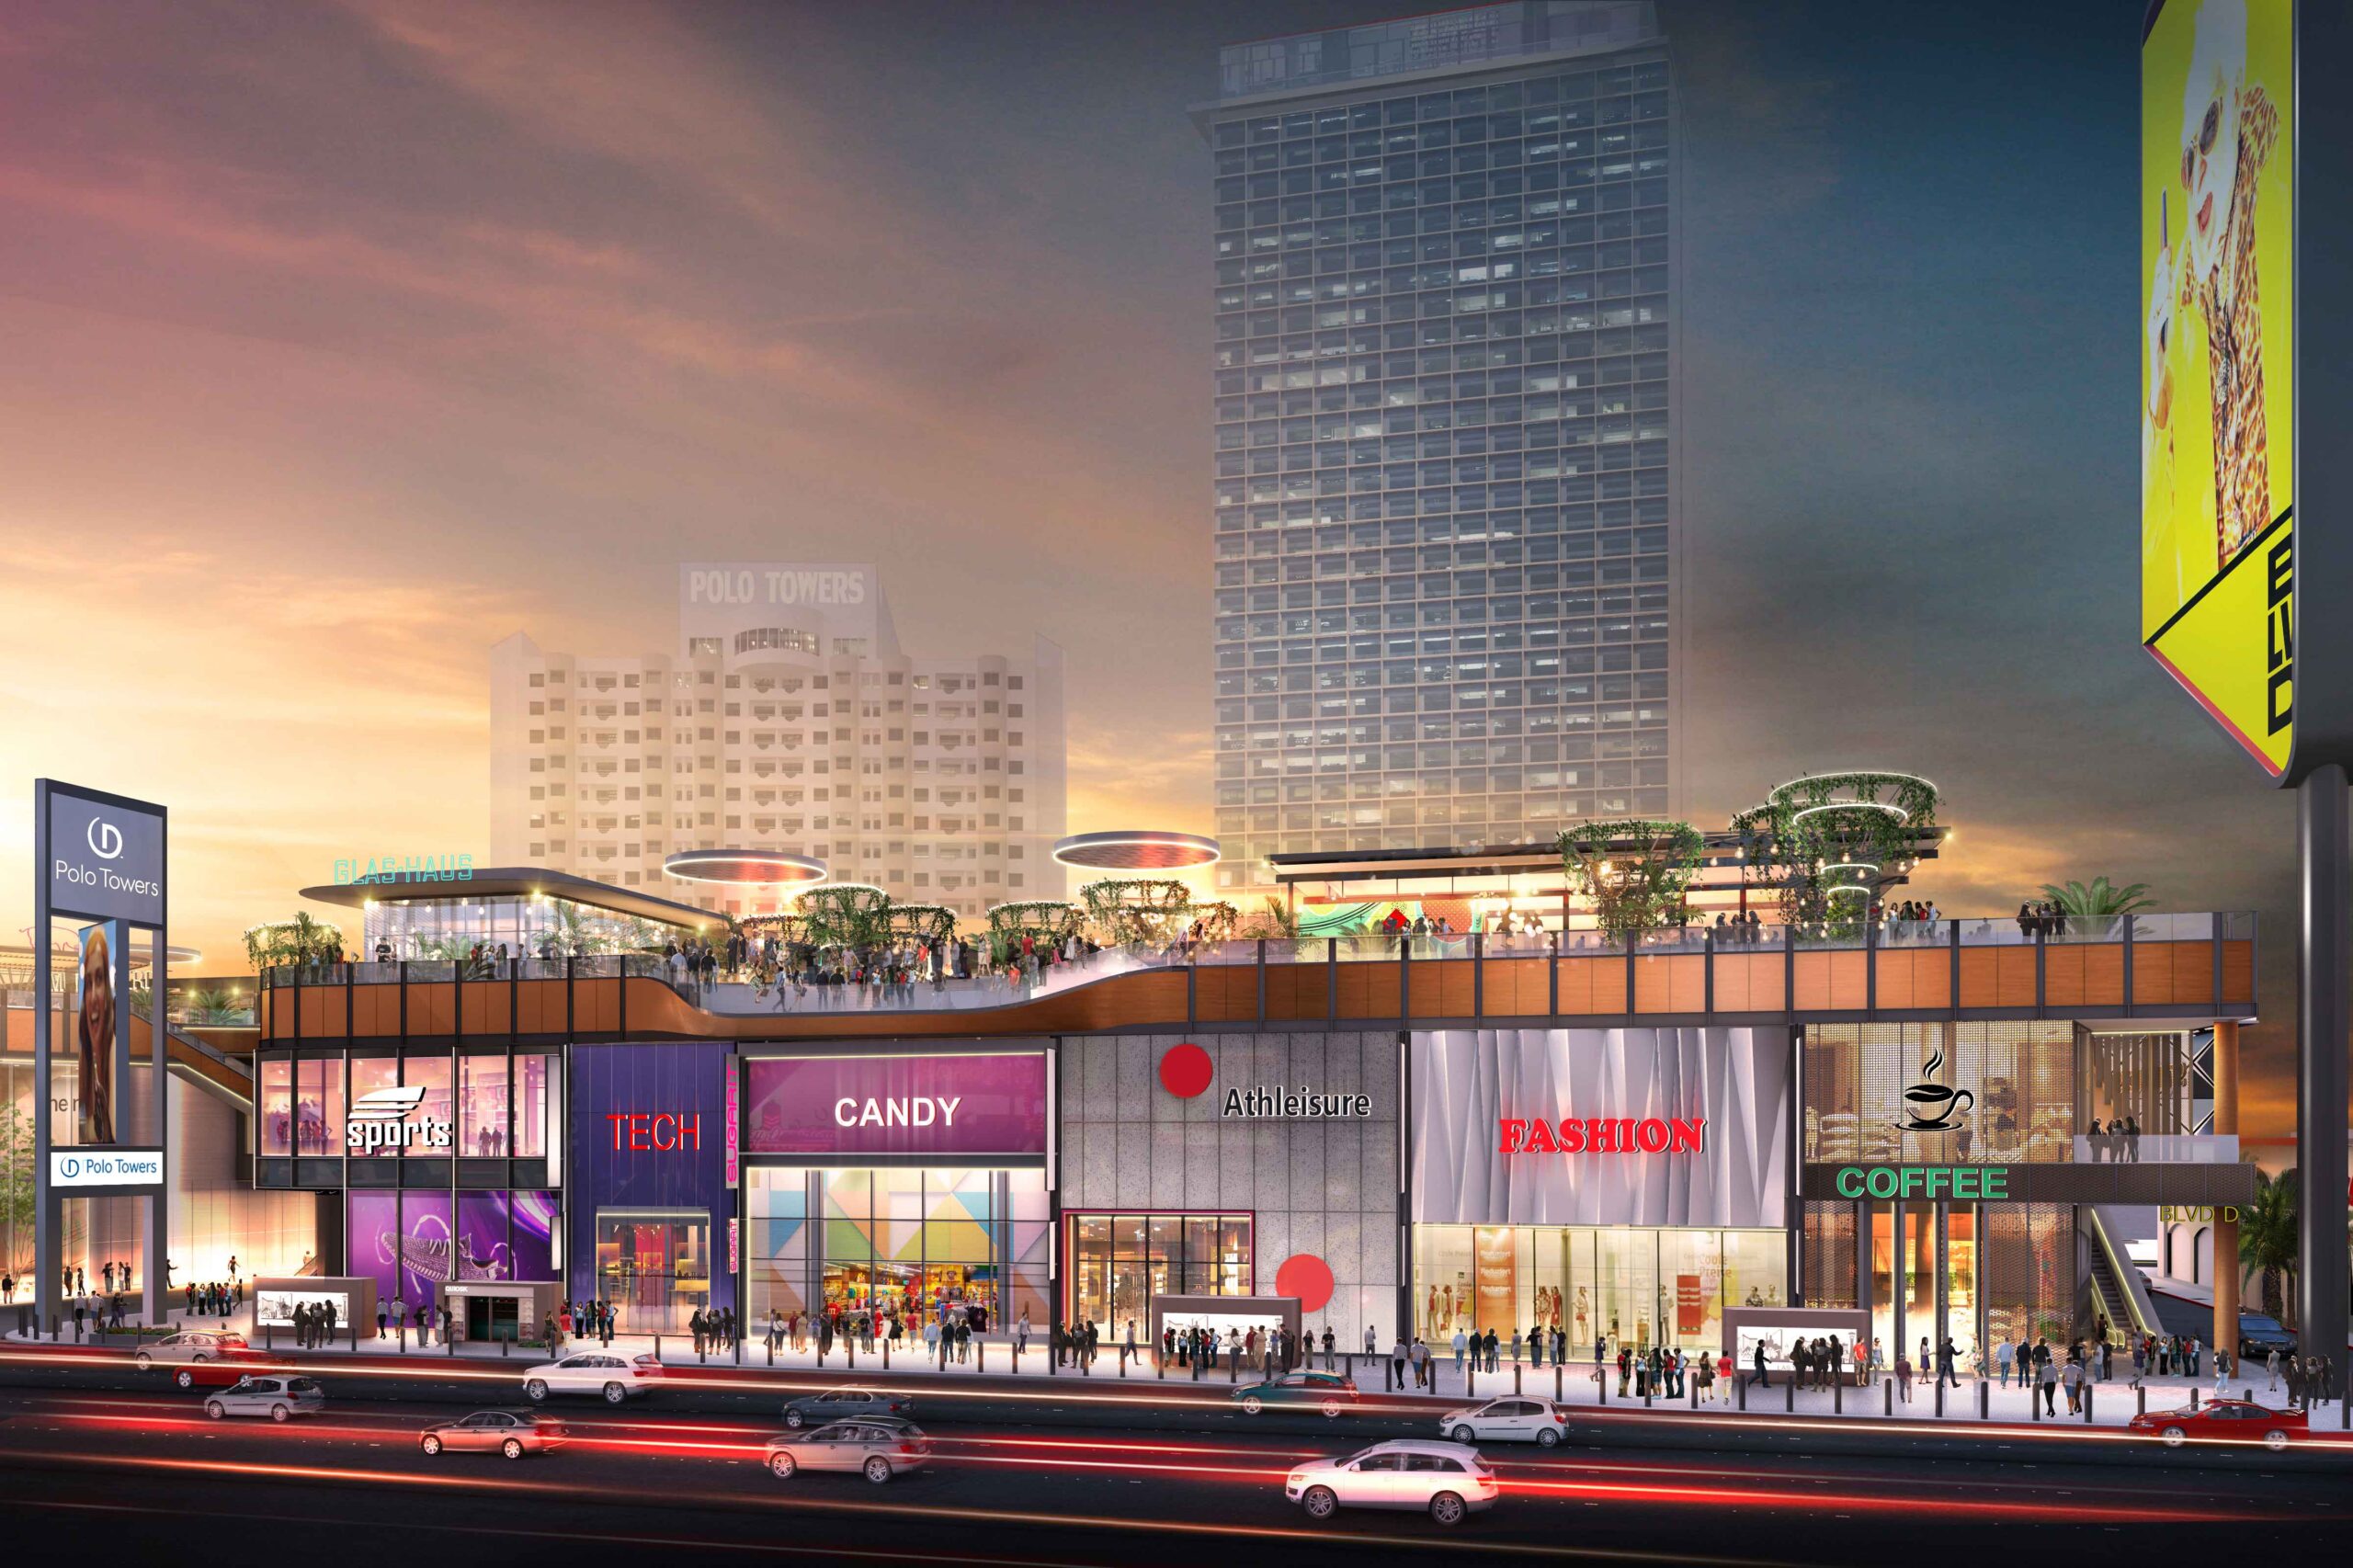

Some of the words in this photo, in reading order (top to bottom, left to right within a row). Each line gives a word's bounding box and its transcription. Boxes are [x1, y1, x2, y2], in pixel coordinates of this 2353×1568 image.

[690, 570, 755, 604] POLO
[765, 570, 865, 604] TOWERS
[56, 859, 97, 885] Polo
[98, 867, 159, 896] Towers
[835, 1097, 962, 1127] CANDY
[1222, 1085, 1371, 1117] Athleisure
[347, 1116, 452, 1154] sports
[606, 1113, 699, 1150] TECH
[1499, 1118, 1707, 1153] FASHION
[86, 1158, 112, 1173] Polo
[115, 1159, 157, 1173] Towers
[1836, 1167, 2007, 1199] COFFEE
[2160, 1205, 2215, 1222] BLVD
